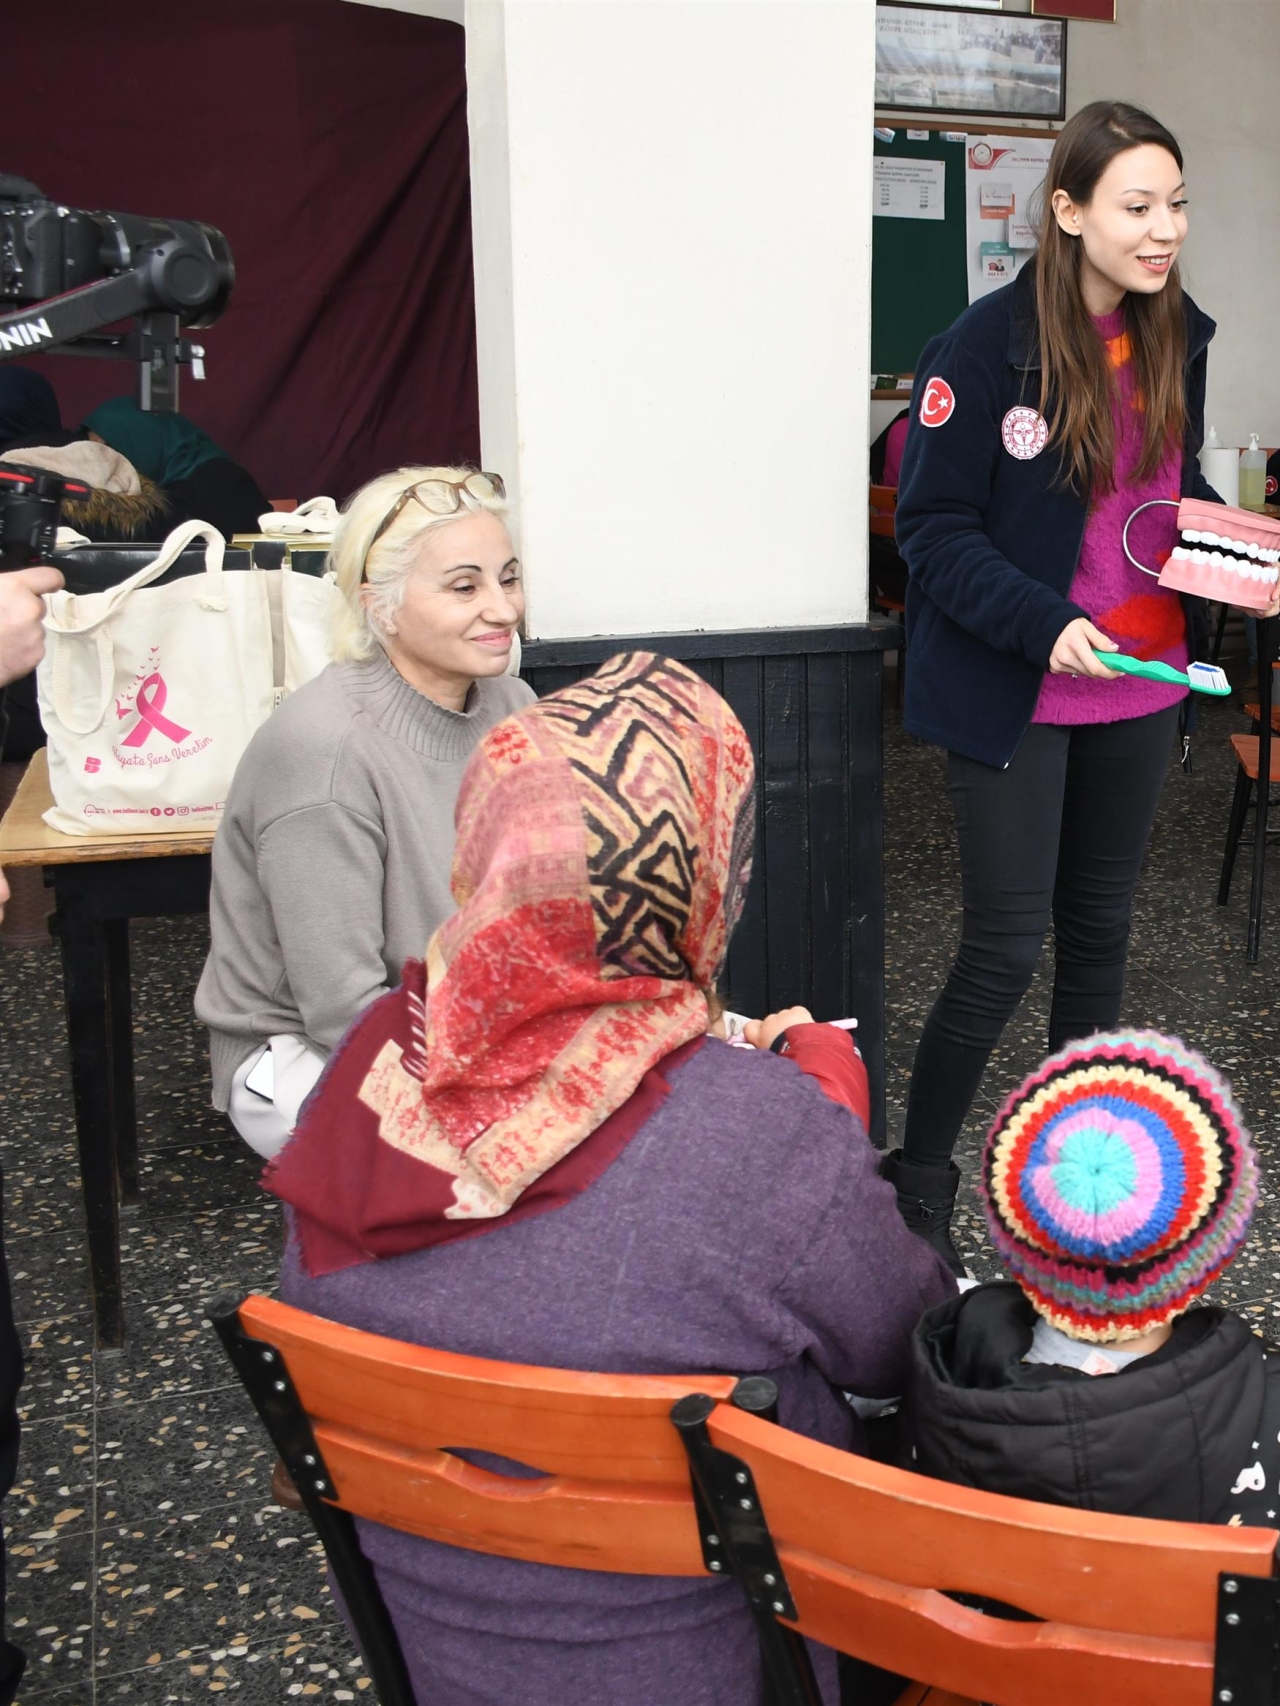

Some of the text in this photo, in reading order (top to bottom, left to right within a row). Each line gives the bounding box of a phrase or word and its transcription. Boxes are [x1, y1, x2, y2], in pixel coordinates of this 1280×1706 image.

[0, 317, 54, 351] NIN
[111, 736, 213, 770] Hayata Şans Verelim
